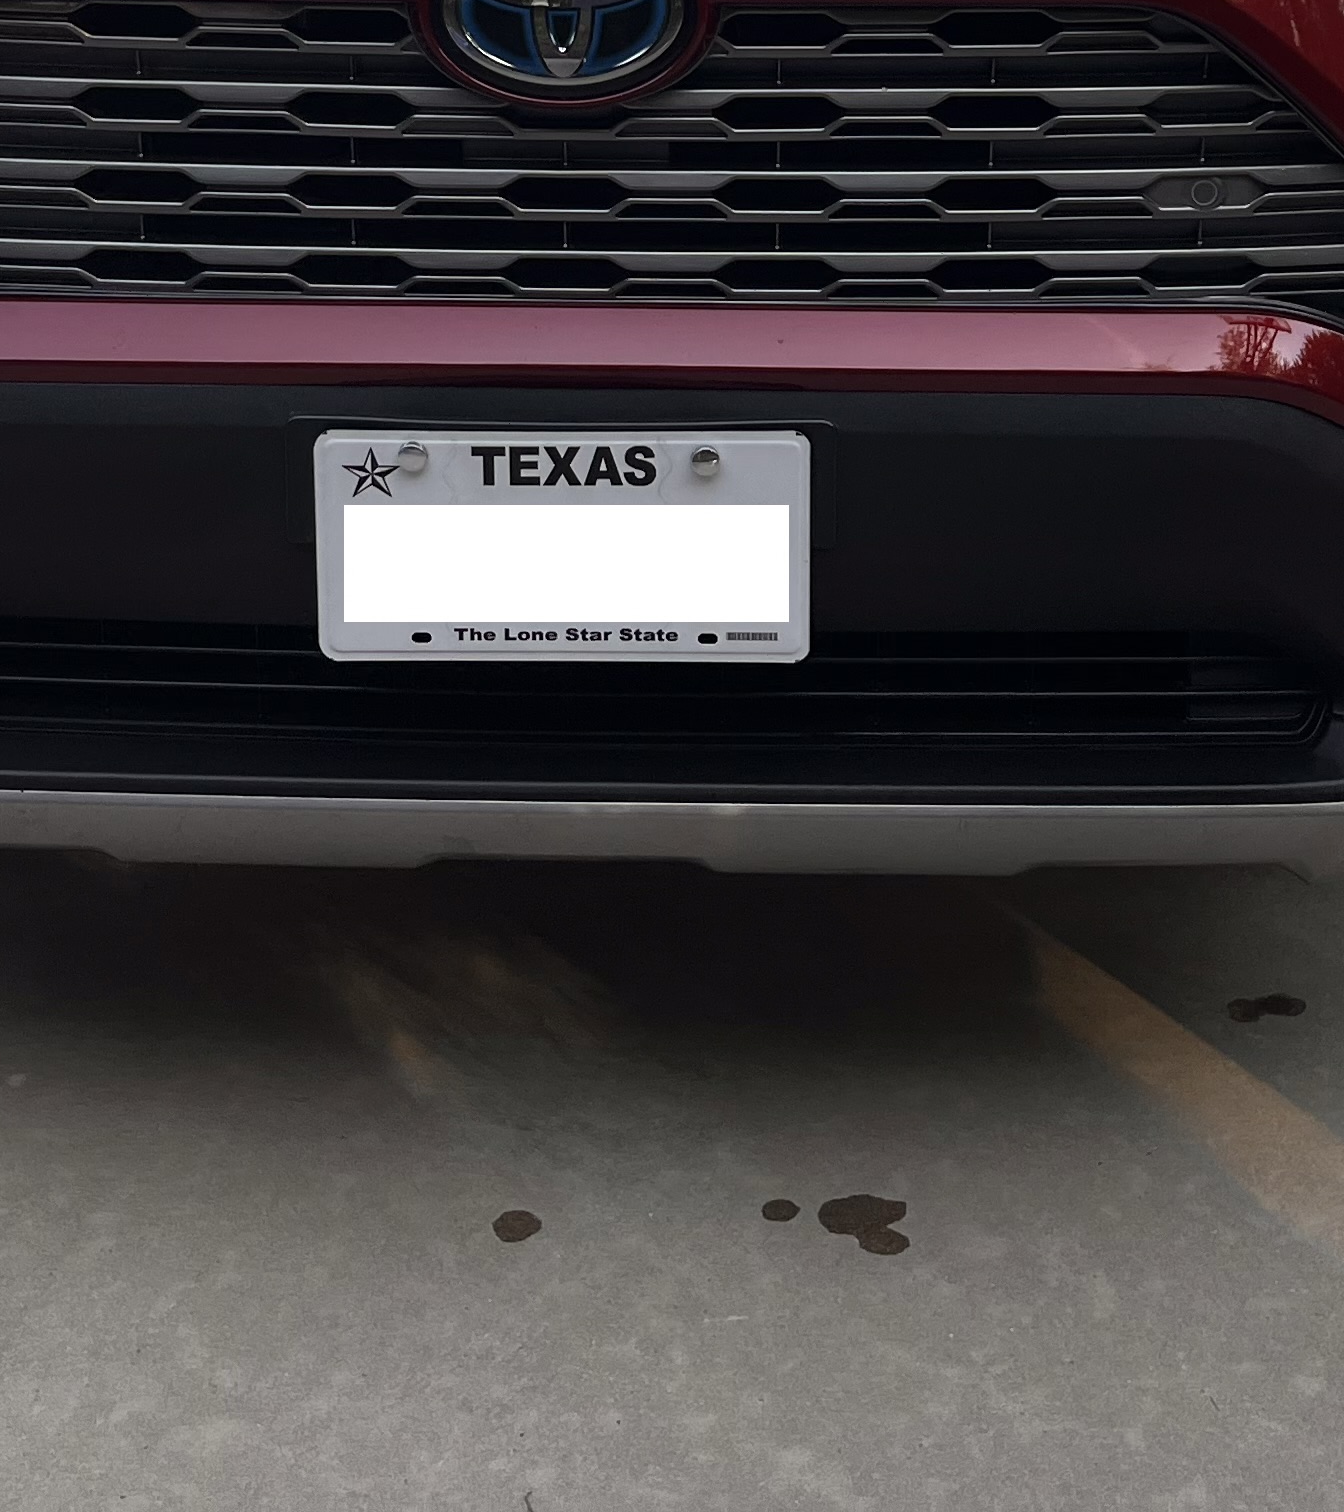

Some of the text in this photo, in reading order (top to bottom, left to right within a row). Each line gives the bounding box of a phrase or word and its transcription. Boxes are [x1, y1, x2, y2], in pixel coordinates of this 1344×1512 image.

[470, 445, 657, 487] TEXAS
[453, 627, 679, 642] The Lone Star State
